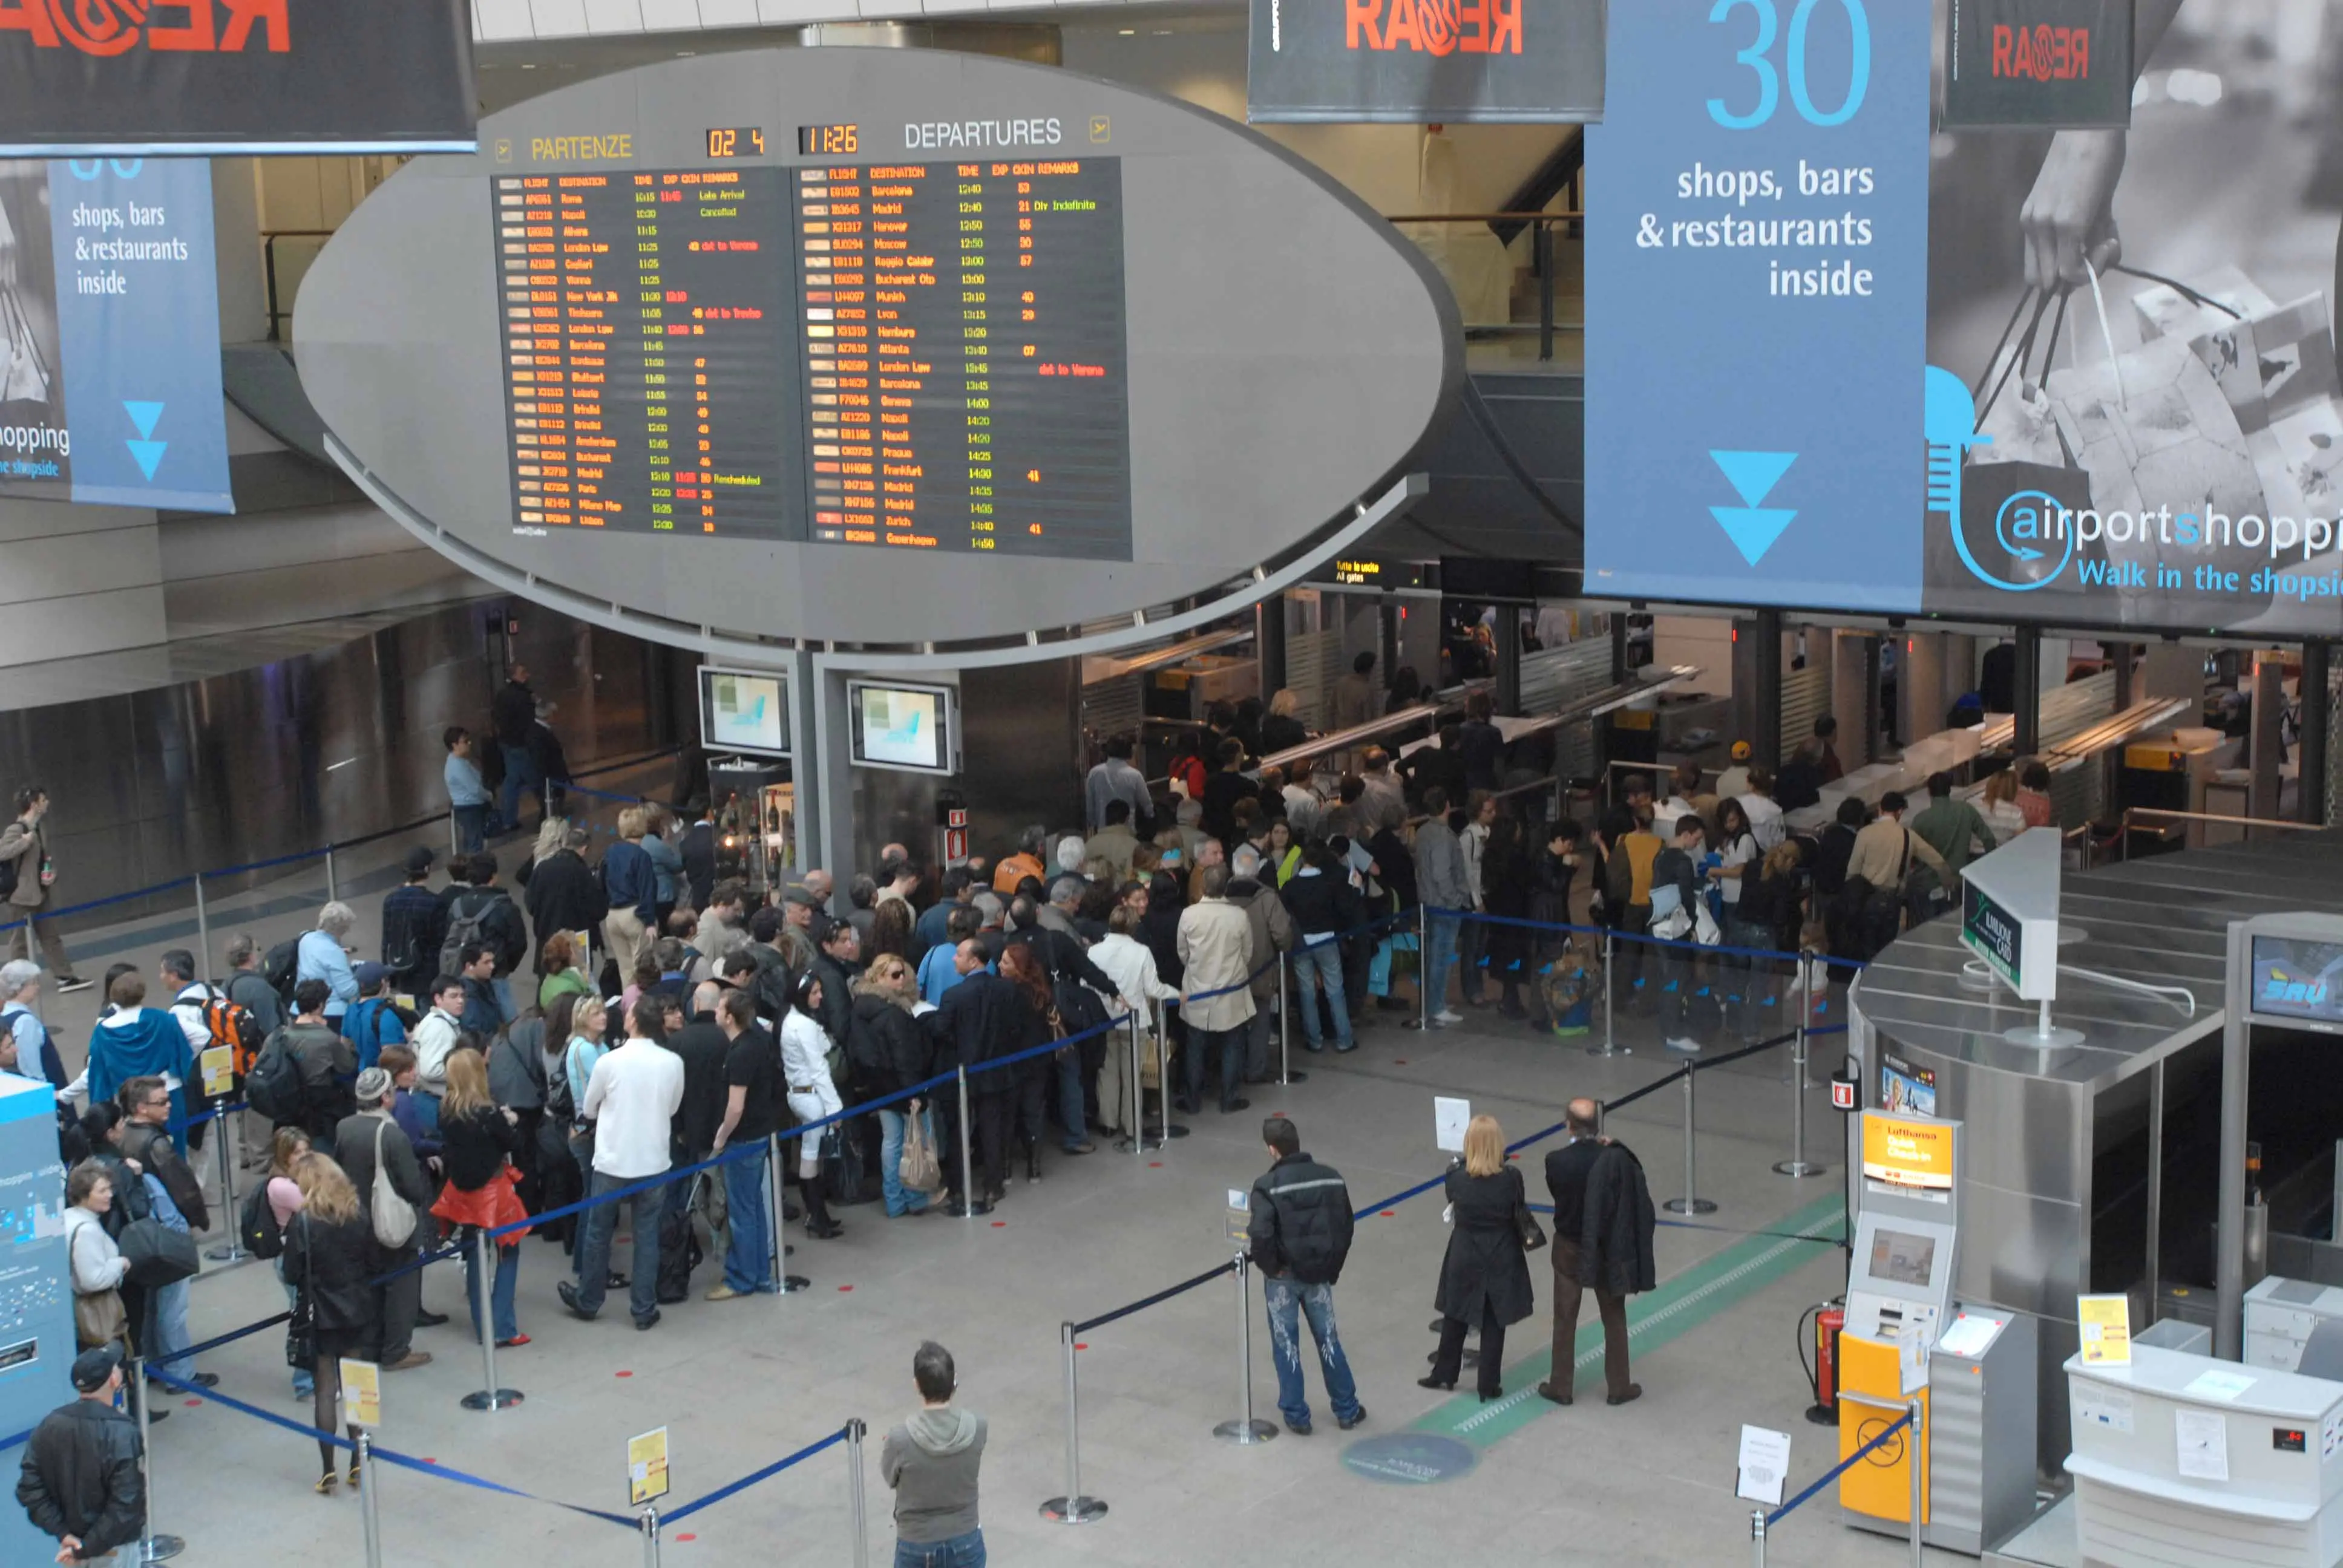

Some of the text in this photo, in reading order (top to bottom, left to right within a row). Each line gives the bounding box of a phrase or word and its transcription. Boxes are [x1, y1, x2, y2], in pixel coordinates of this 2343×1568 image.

[1706, 0, 1870, 129] 30
[710, 129, 764, 157] 02 4
[811, 125, 857, 152] 11:26
[905, 119, 1061, 148] DEPARTURES
[532, 134, 633, 160] PARTENZE
[559, 177, 608, 188] DESTINATION
[869, 166, 926, 180] DESTINATION
[958, 165, 980, 177] TIME
[1038, 162, 1080, 174] REMARKS
[1678, 160, 1873, 206] shops, bars
[720, 189, 745, 200] Arrival
[871, 185, 914, 198] Barcelona
[73, 201, 165, 232] shops, bars
[872, 203, 903, 215] Madrid
[1053, 201, 1095, 211] Indefinite
[1672, 212, 1872, 247] restaurants
[93, 237, 188, 261] restaurants
[874, 238, 908, 250] Moscow
[78, 270, 126, 294] inside
[874, 273, 916, 285] Bucharest
[1771, 260, 1873, 296] inside
[878, 343, 910, 355] Atlanta
[879, 377, 922, 390] Barcelona
[883, 463, 923, 477] Frankfurt
[2077, 558, 2146, 587] Walk
[2157, 563, 2181, 589] in
[2194, 565, 2239, 592] the
[1887, 1126, 1936, 1140] Lufthansa
